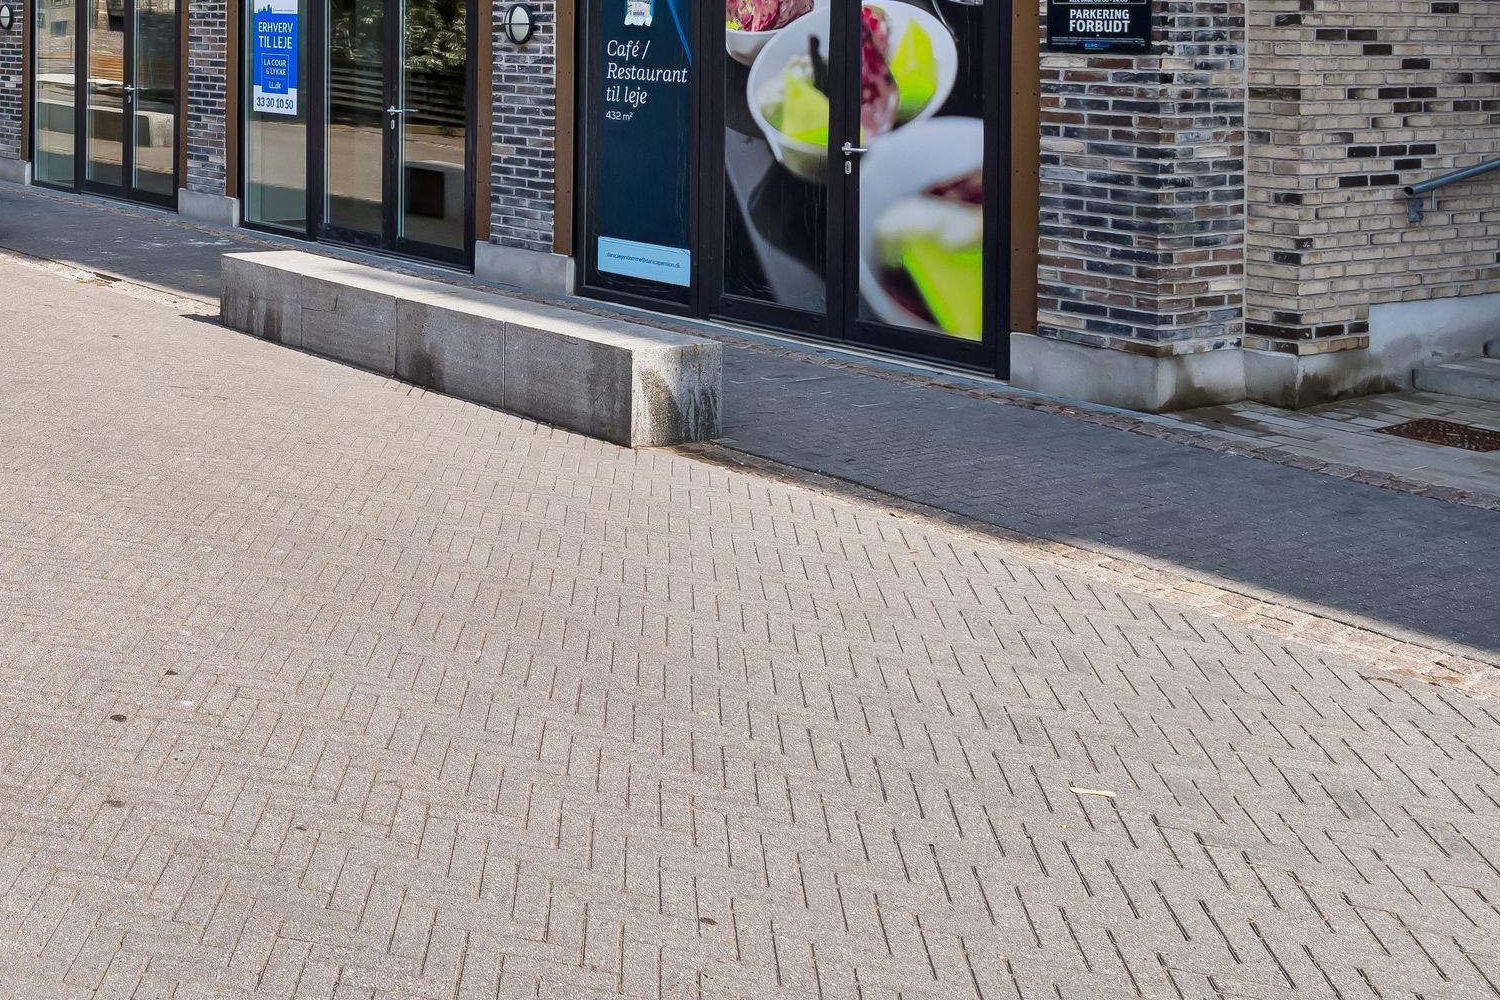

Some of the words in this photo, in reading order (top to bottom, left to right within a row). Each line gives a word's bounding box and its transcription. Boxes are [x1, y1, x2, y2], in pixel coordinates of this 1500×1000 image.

[1070, 9, 1130, 19] PARKERING
[258, 22, 293, 34] ERHVERV
[1069, 20, 1130, 32] FORBUDT
[258, 36, 272, 48] TIL
[274, 36, 292, 50] LEJE
[607, 40, 640, 61] Café
[642, 40, 650, 60] /
[271, 59, 286, 67] COUR
[270, 68, 286, 76] LYKKE
[606, 62, 688, 83] Restaurant
[256, 96, 265, 107] 33
[266, 98, 275, 108] 30
[276, 99, 284, 109] 10
[285, 99, 294, 110] 50
[606, 86, 620, 102] til
[624, 86, 648, 108] leje
[606, 111, 621, 120] 432
